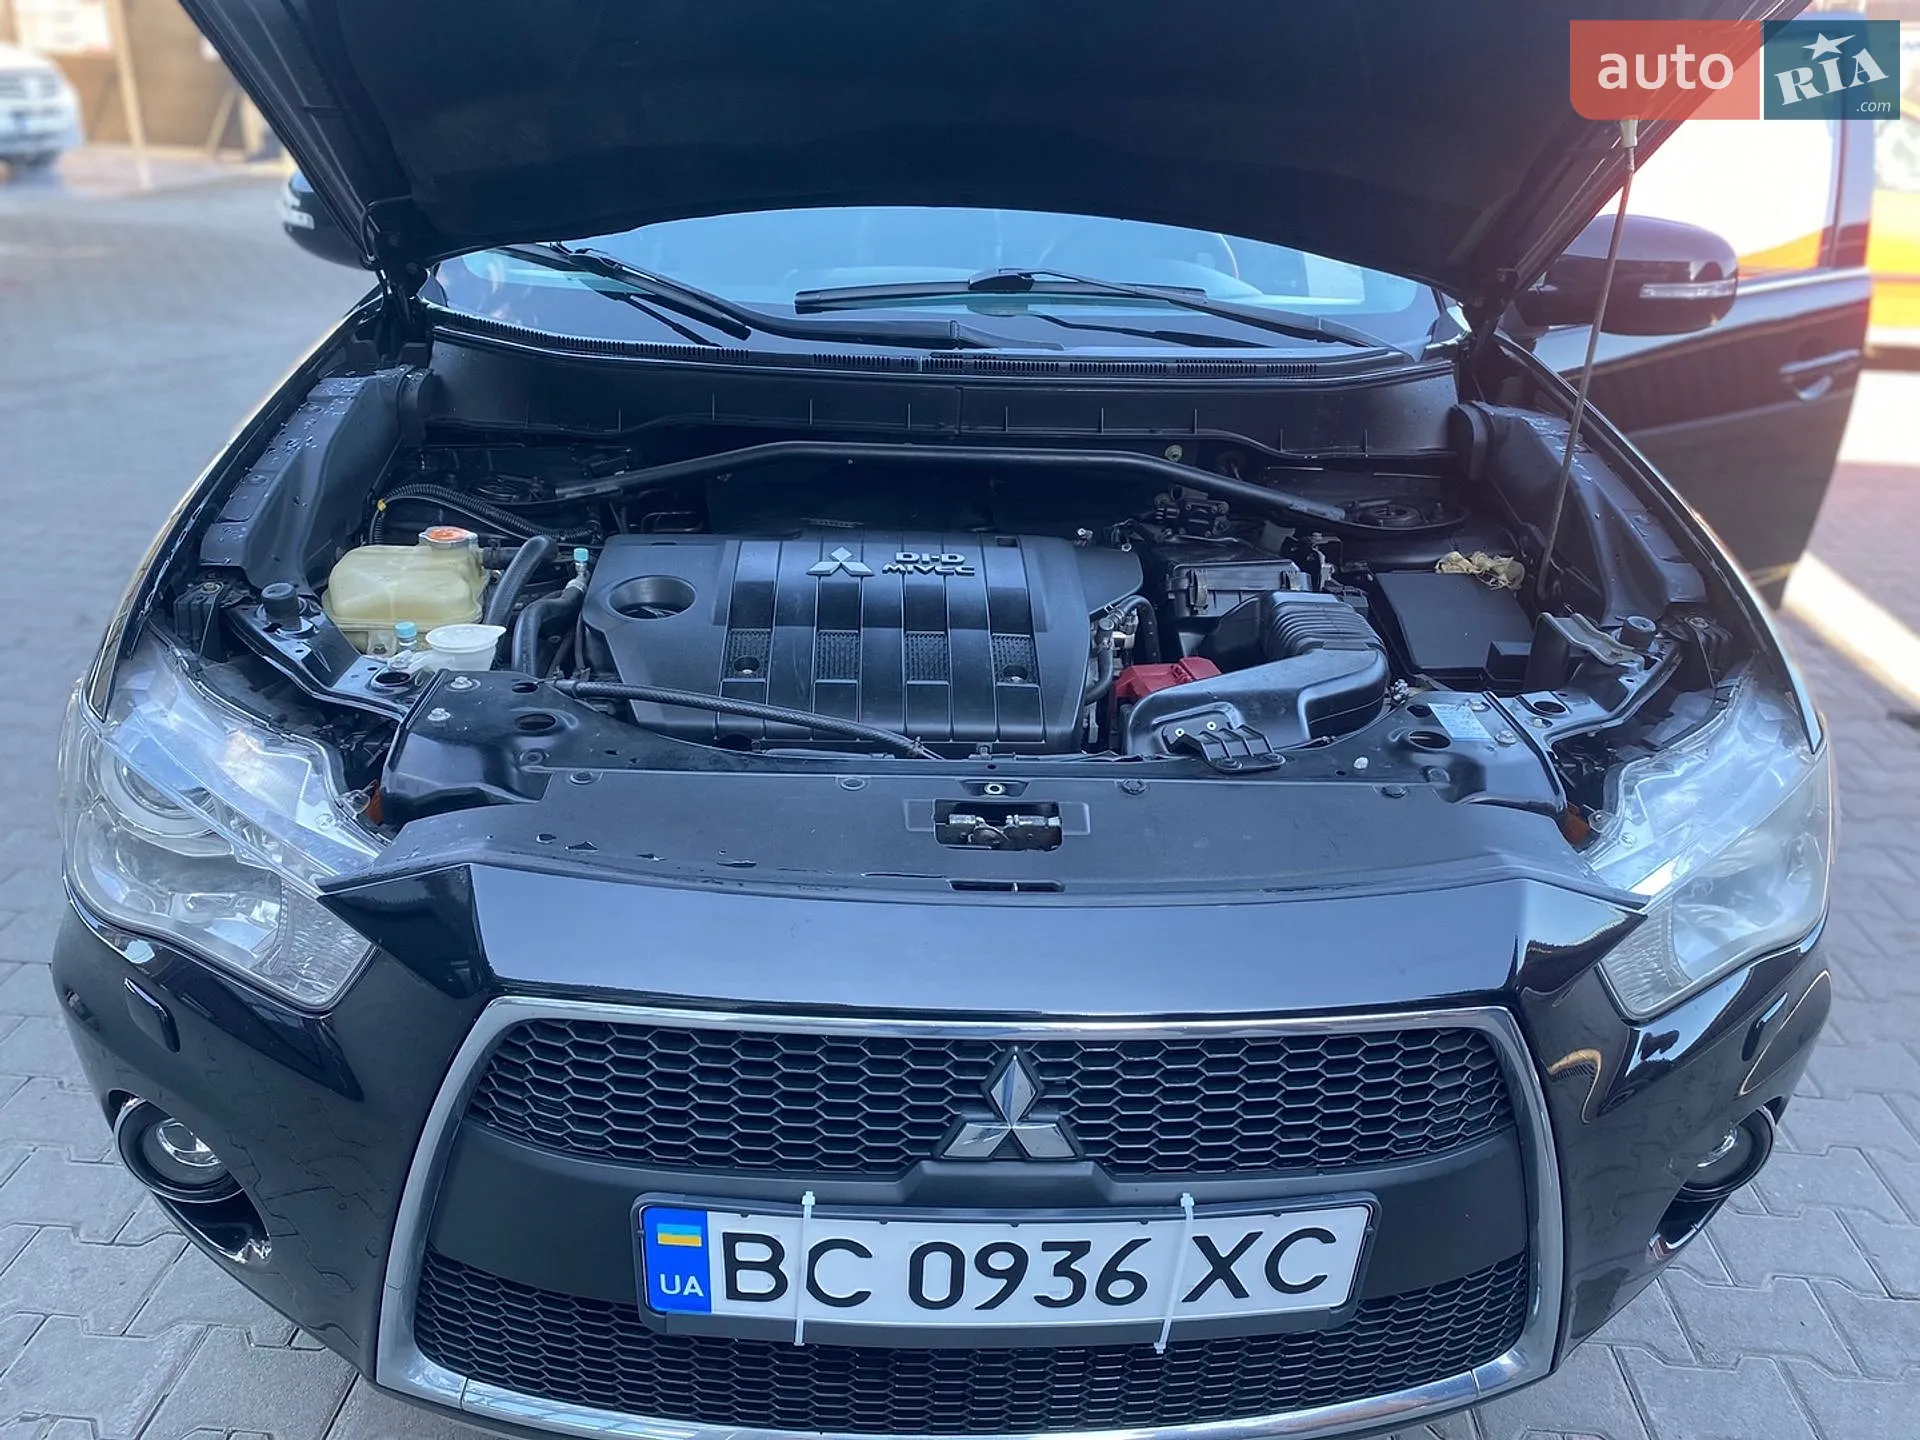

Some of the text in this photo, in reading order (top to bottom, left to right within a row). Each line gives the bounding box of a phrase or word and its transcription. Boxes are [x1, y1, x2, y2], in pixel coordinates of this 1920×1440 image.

[895, 552, 965, 565] DI-D
[722, 1227, 1337, 1311] BC 0936 XC
[660, 1273, 704, 1297] UA
